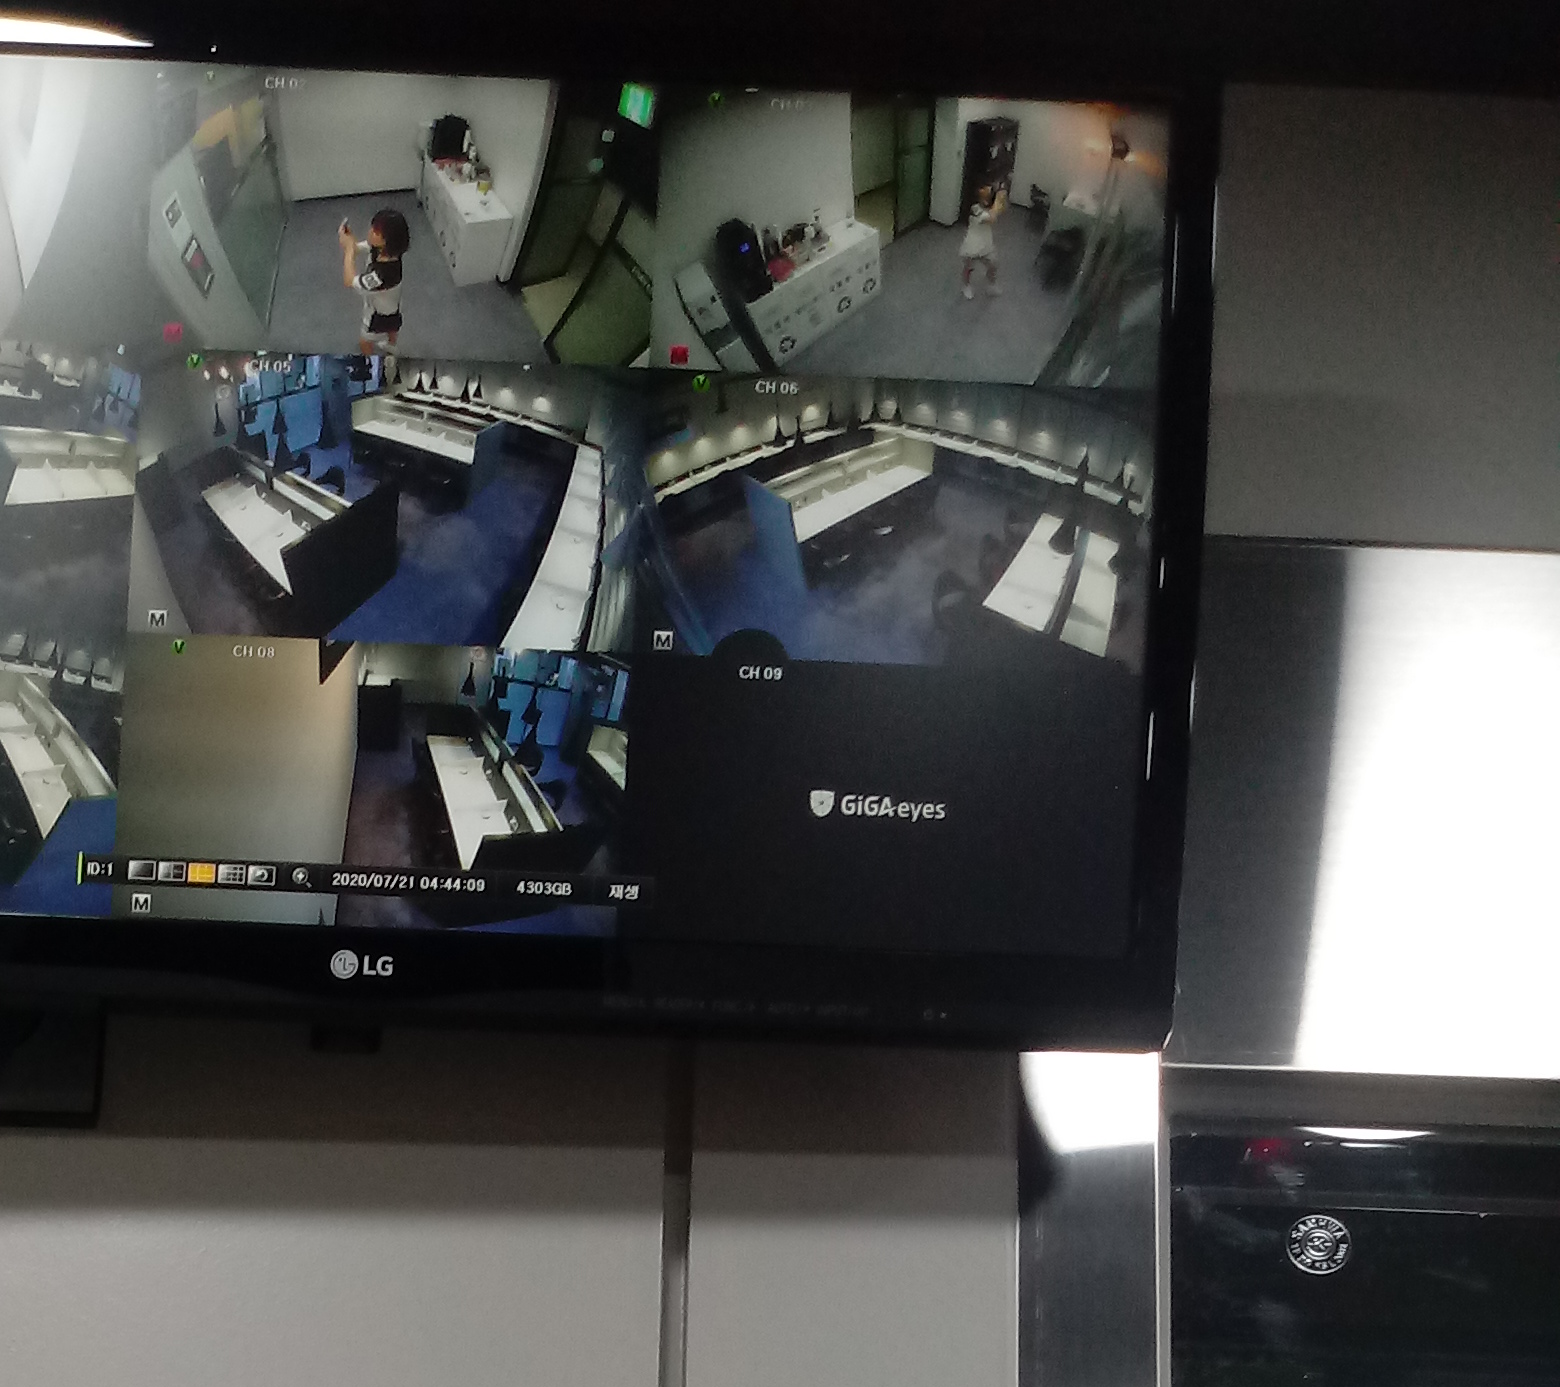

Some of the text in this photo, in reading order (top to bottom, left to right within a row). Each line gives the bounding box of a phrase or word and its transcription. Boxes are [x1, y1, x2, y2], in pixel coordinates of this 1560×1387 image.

[264, 75, 285, 89] CH
[249, 359, 291, 373] CH 05
[754, 380, 799, 395] CH 06
[232, 645, 275, 659] CH 08
[739, 666, 783, 680] CH 09
[86, 861, 114, 877] ID:1
[331, 873, 415, 891] 2020/07/21
[419, 875, 486, 892] 04:44:09
[516, 881, 572, 896] 4303GB
[362, 954, 394, 976] LG
